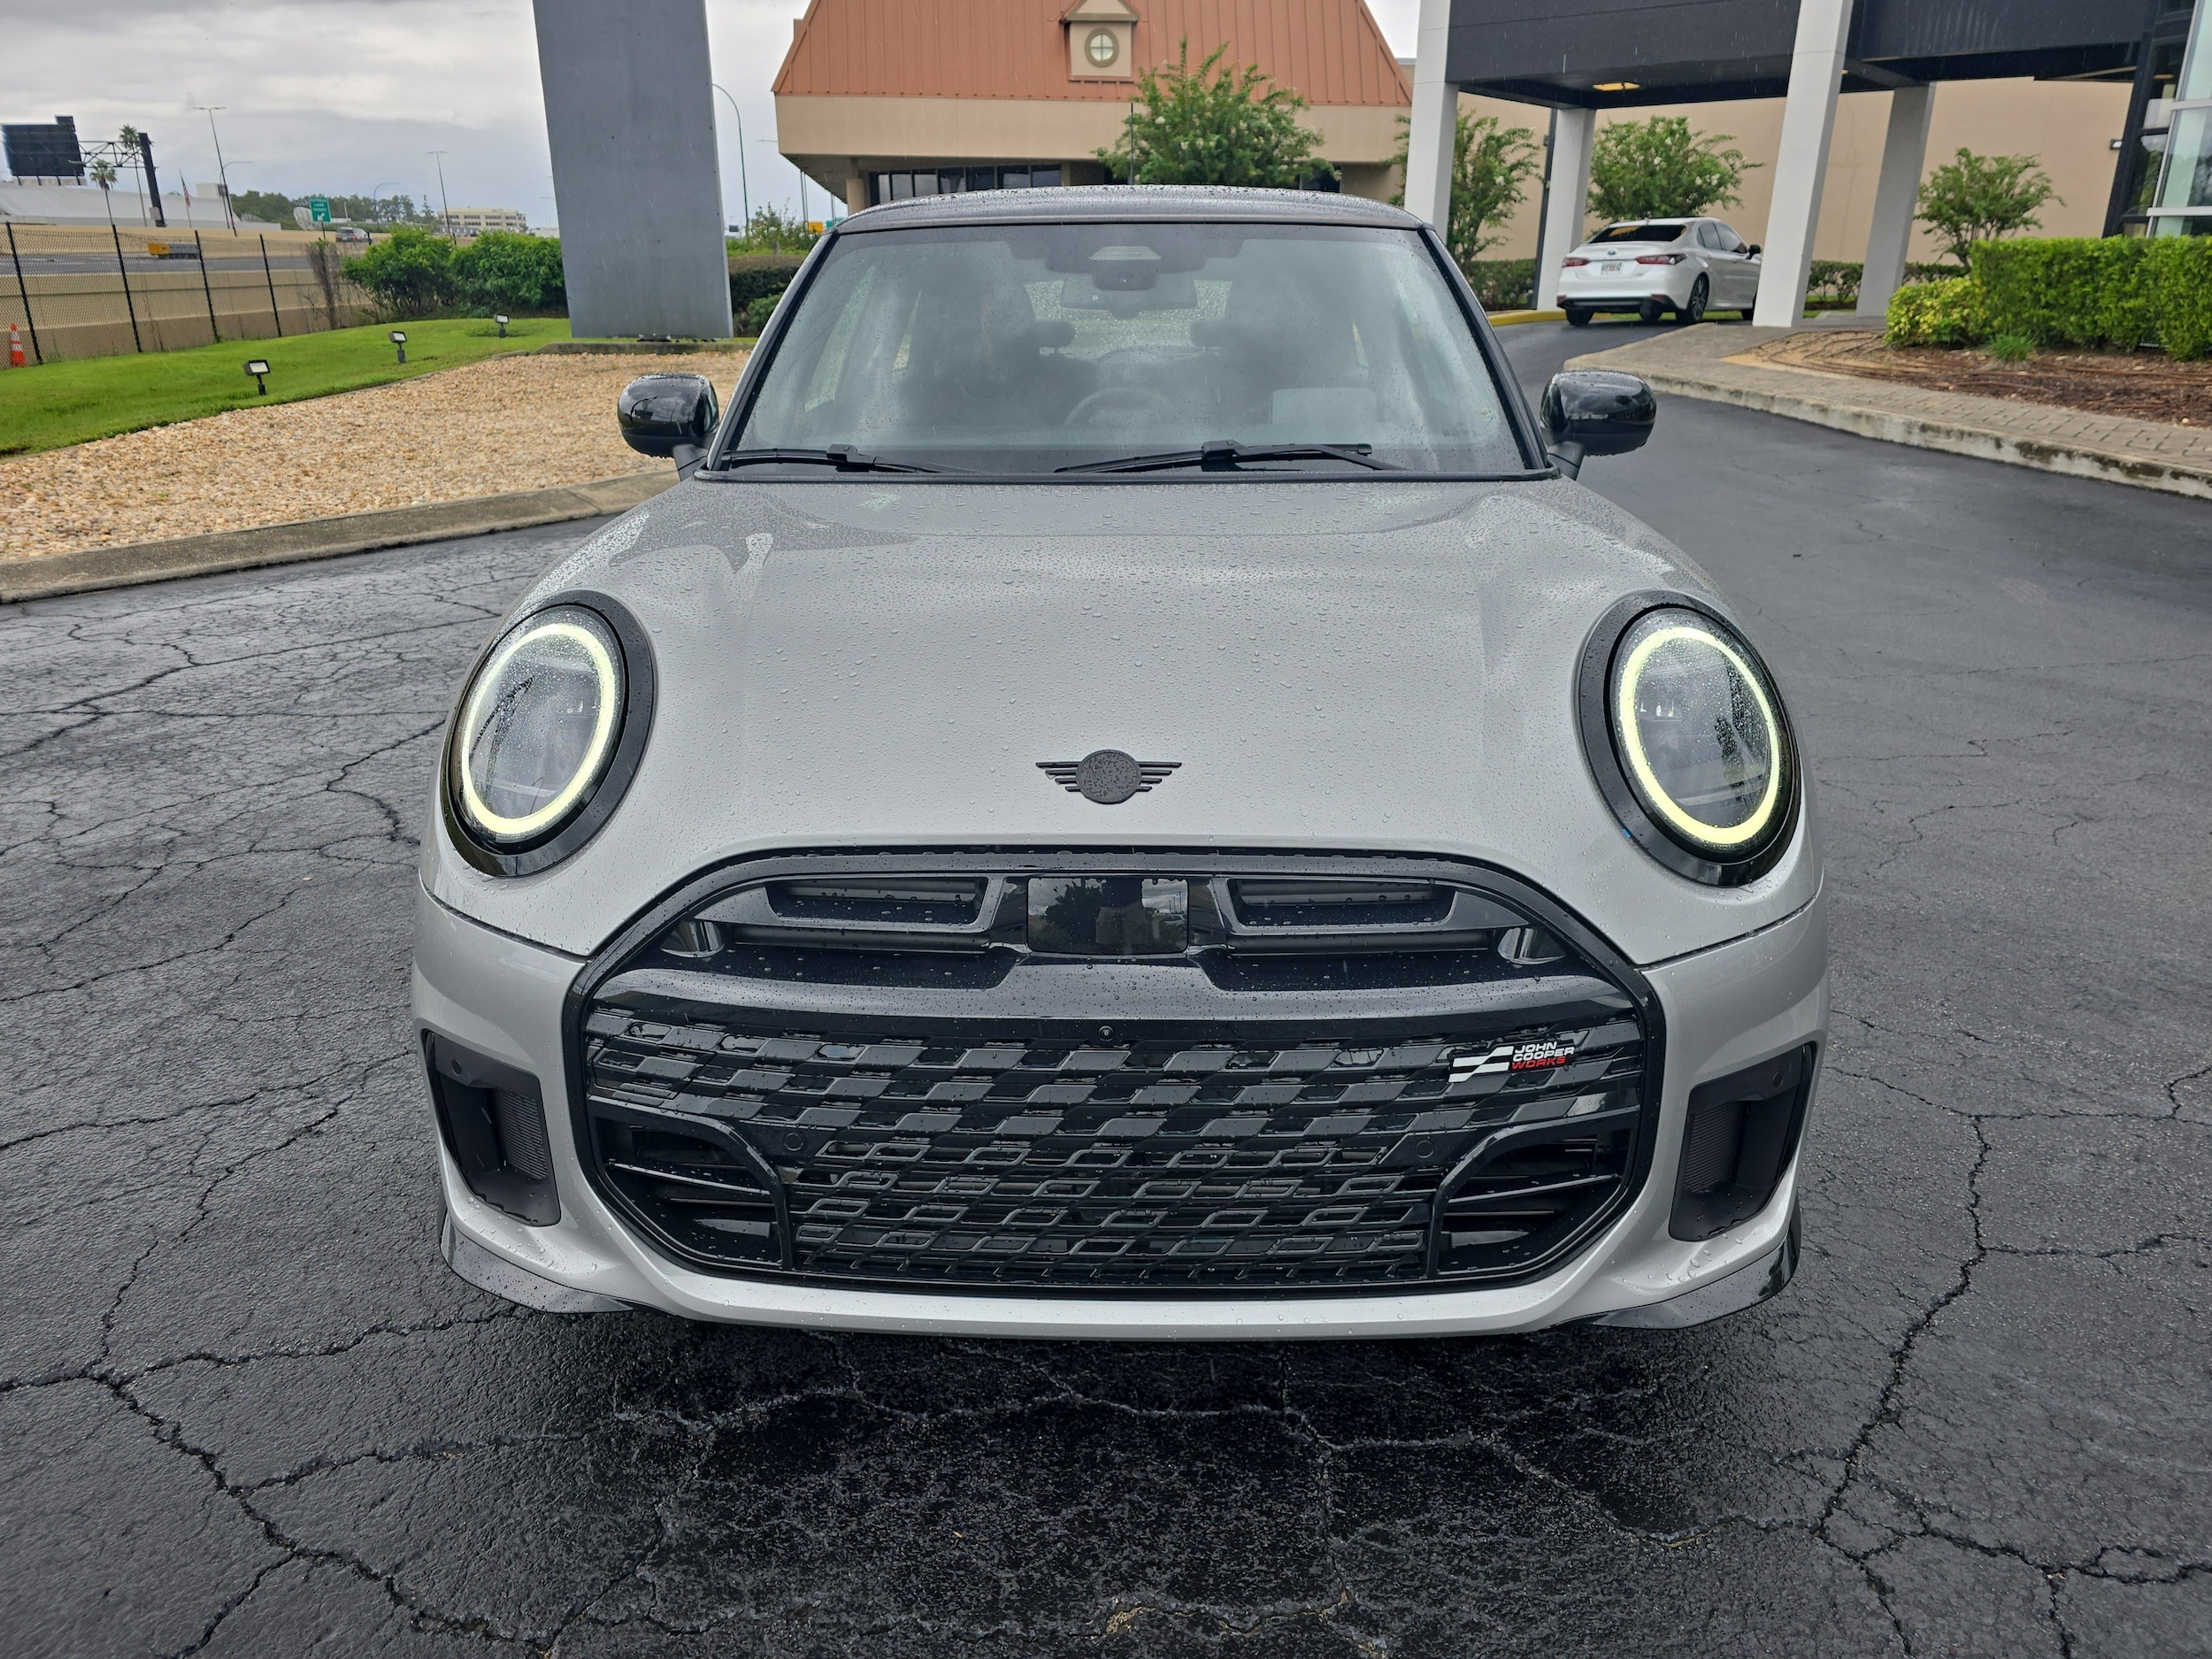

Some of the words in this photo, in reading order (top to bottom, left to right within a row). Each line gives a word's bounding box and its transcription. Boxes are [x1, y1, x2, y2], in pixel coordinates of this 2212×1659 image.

[1515, 1041, 1557, 1053] JOHN
[1512, 1047, 1575, 1062] COOPER
[1512, 1056, 1566, 1069] WORKS
